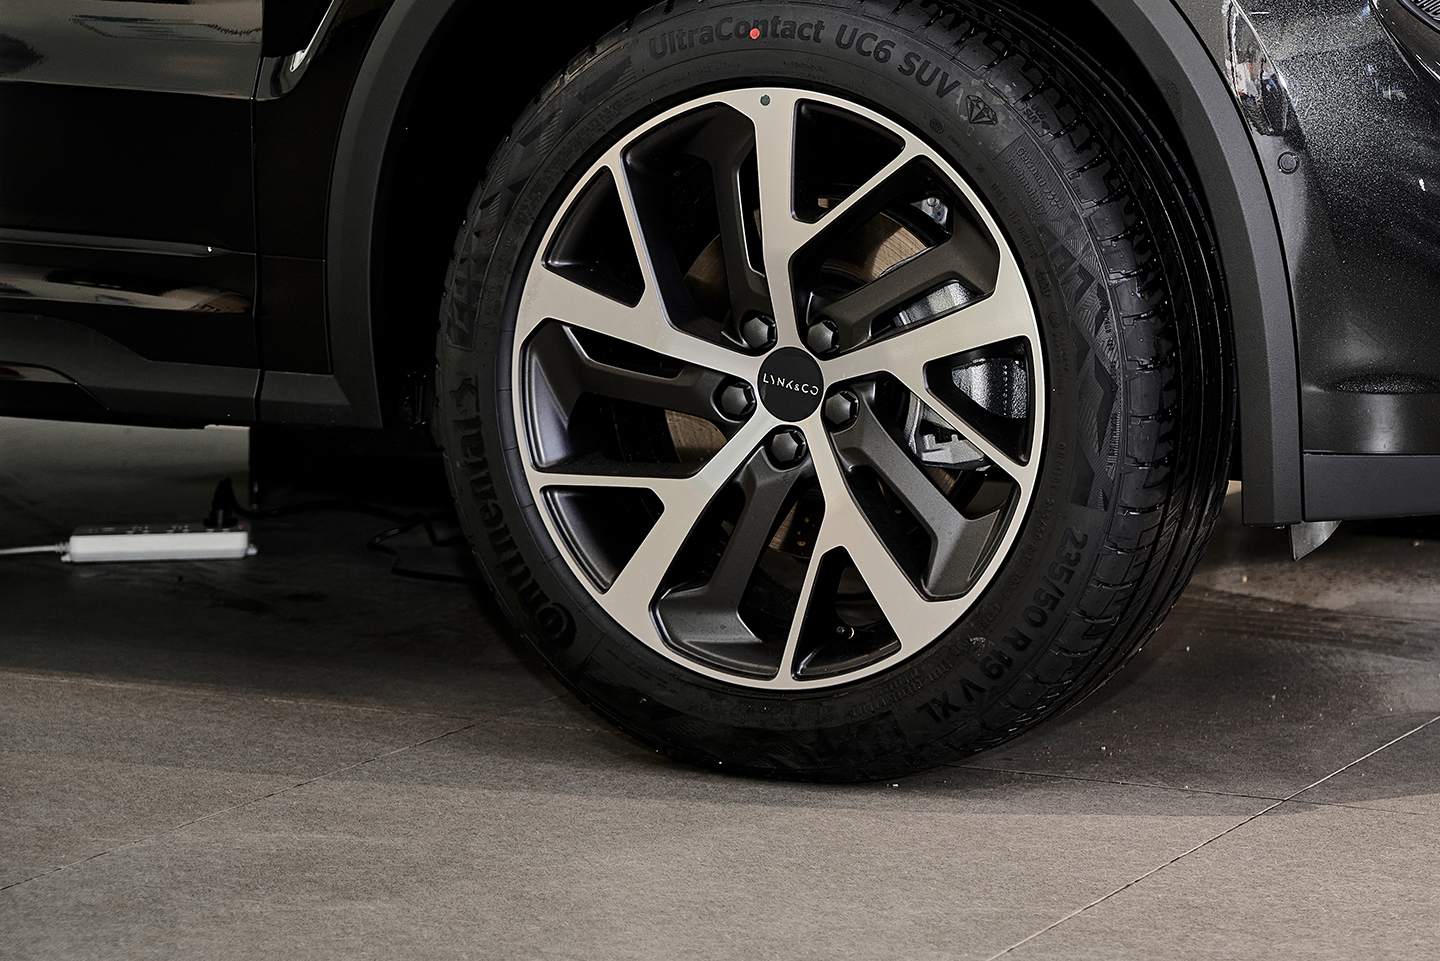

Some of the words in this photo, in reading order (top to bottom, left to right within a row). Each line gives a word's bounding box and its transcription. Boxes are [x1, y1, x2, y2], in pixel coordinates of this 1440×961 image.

[648, 14, 825, 60] UltraContact
[836, 24, 894, 63] UC6
[898, 50, 960, 99] SUV
[1023, 108, 1040, 125] SUV
[1016, 147, 1045, 186] German
[1005, 154, 1047, 216] Technology
[762, 373, 819, 396] LYNK&CO
[453, 415, 578, 653] Continental
[1023, 526, 1088, 630] 235/50
[1003, 626, 1034, 651] R
[980, 647, 1014, 679] 19
[958, 675, 986, 703] V
[916, 690, 962, 725] XL
